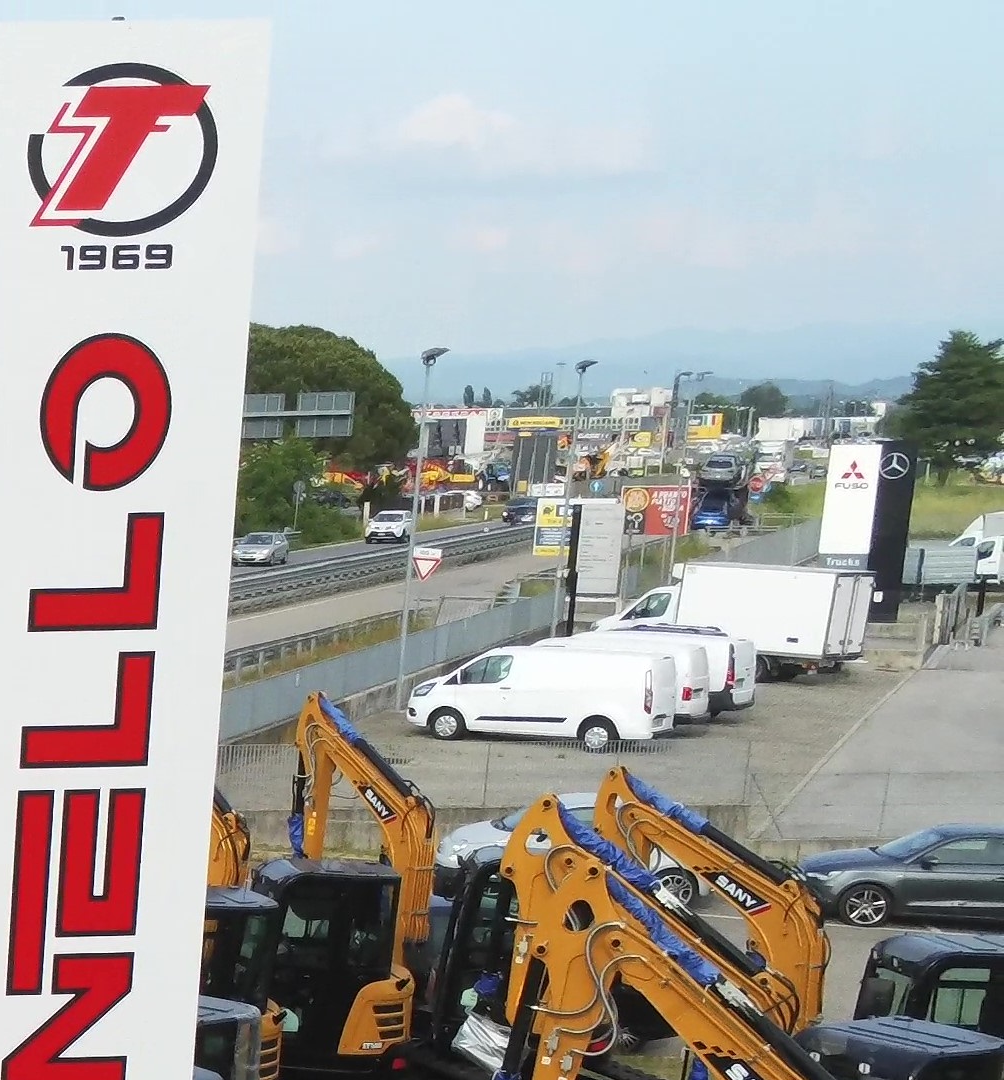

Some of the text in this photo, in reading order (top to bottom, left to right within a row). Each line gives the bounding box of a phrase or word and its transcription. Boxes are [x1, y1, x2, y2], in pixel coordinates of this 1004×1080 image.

[61, 244, 173, 271] 1969
[834, 482, 869, 490] FUSO
[826, 556, 860, 567] Trucks
[364, 788, 389, 818] SANY
[715, 874, 757, 908] SANY
